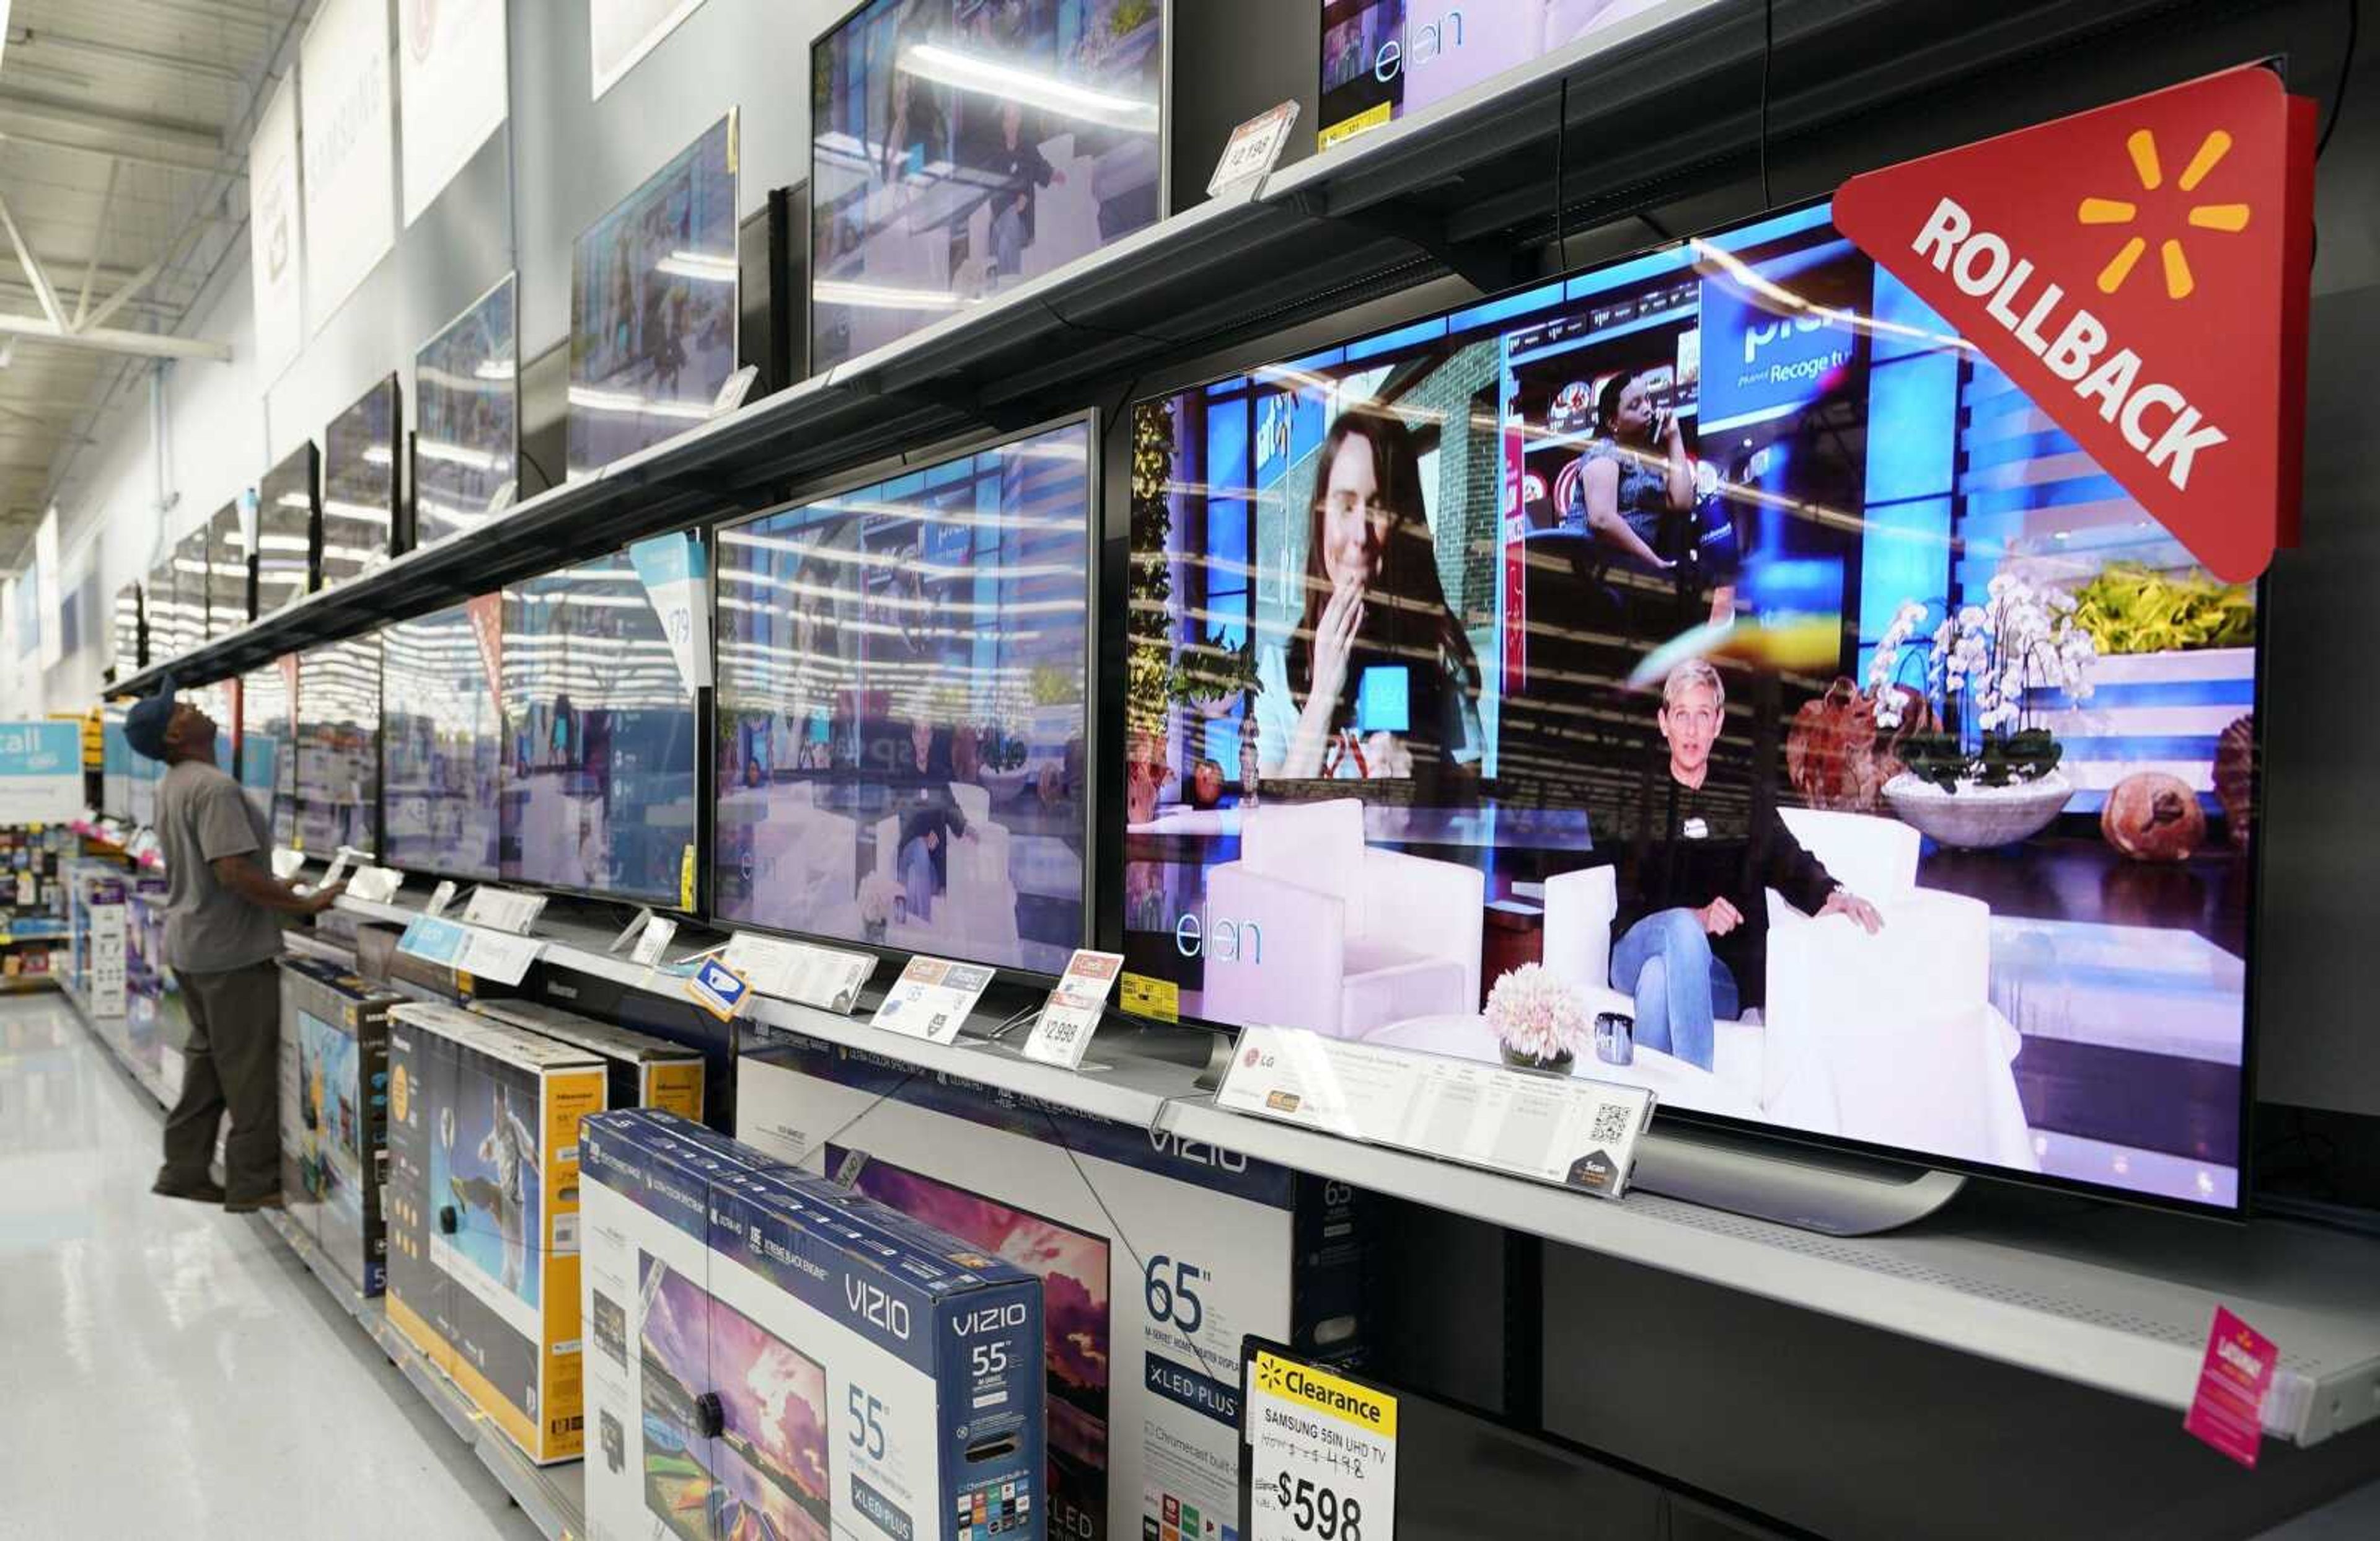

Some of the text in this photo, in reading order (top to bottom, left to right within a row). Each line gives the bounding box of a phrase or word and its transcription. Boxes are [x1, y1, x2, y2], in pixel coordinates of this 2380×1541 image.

[1771, 356, 1828, 385] Recoge
[1911, 197, 2228, 492] ROLLBACK
[845, 1273, 909, 1341] VIZIO
[953, 1303, 1026, 1336] VIZIO
[1197, 1385, 1235, 1416] PLUS
[1285, 1371, 1381, 1423] Clearance
[1266, 1408, 1386, 1464] SAMSUNG 55IN UHD TV
[884, 1507, 910, 1540] PLUS
[1278, 1470, 1362, 1541] $598
